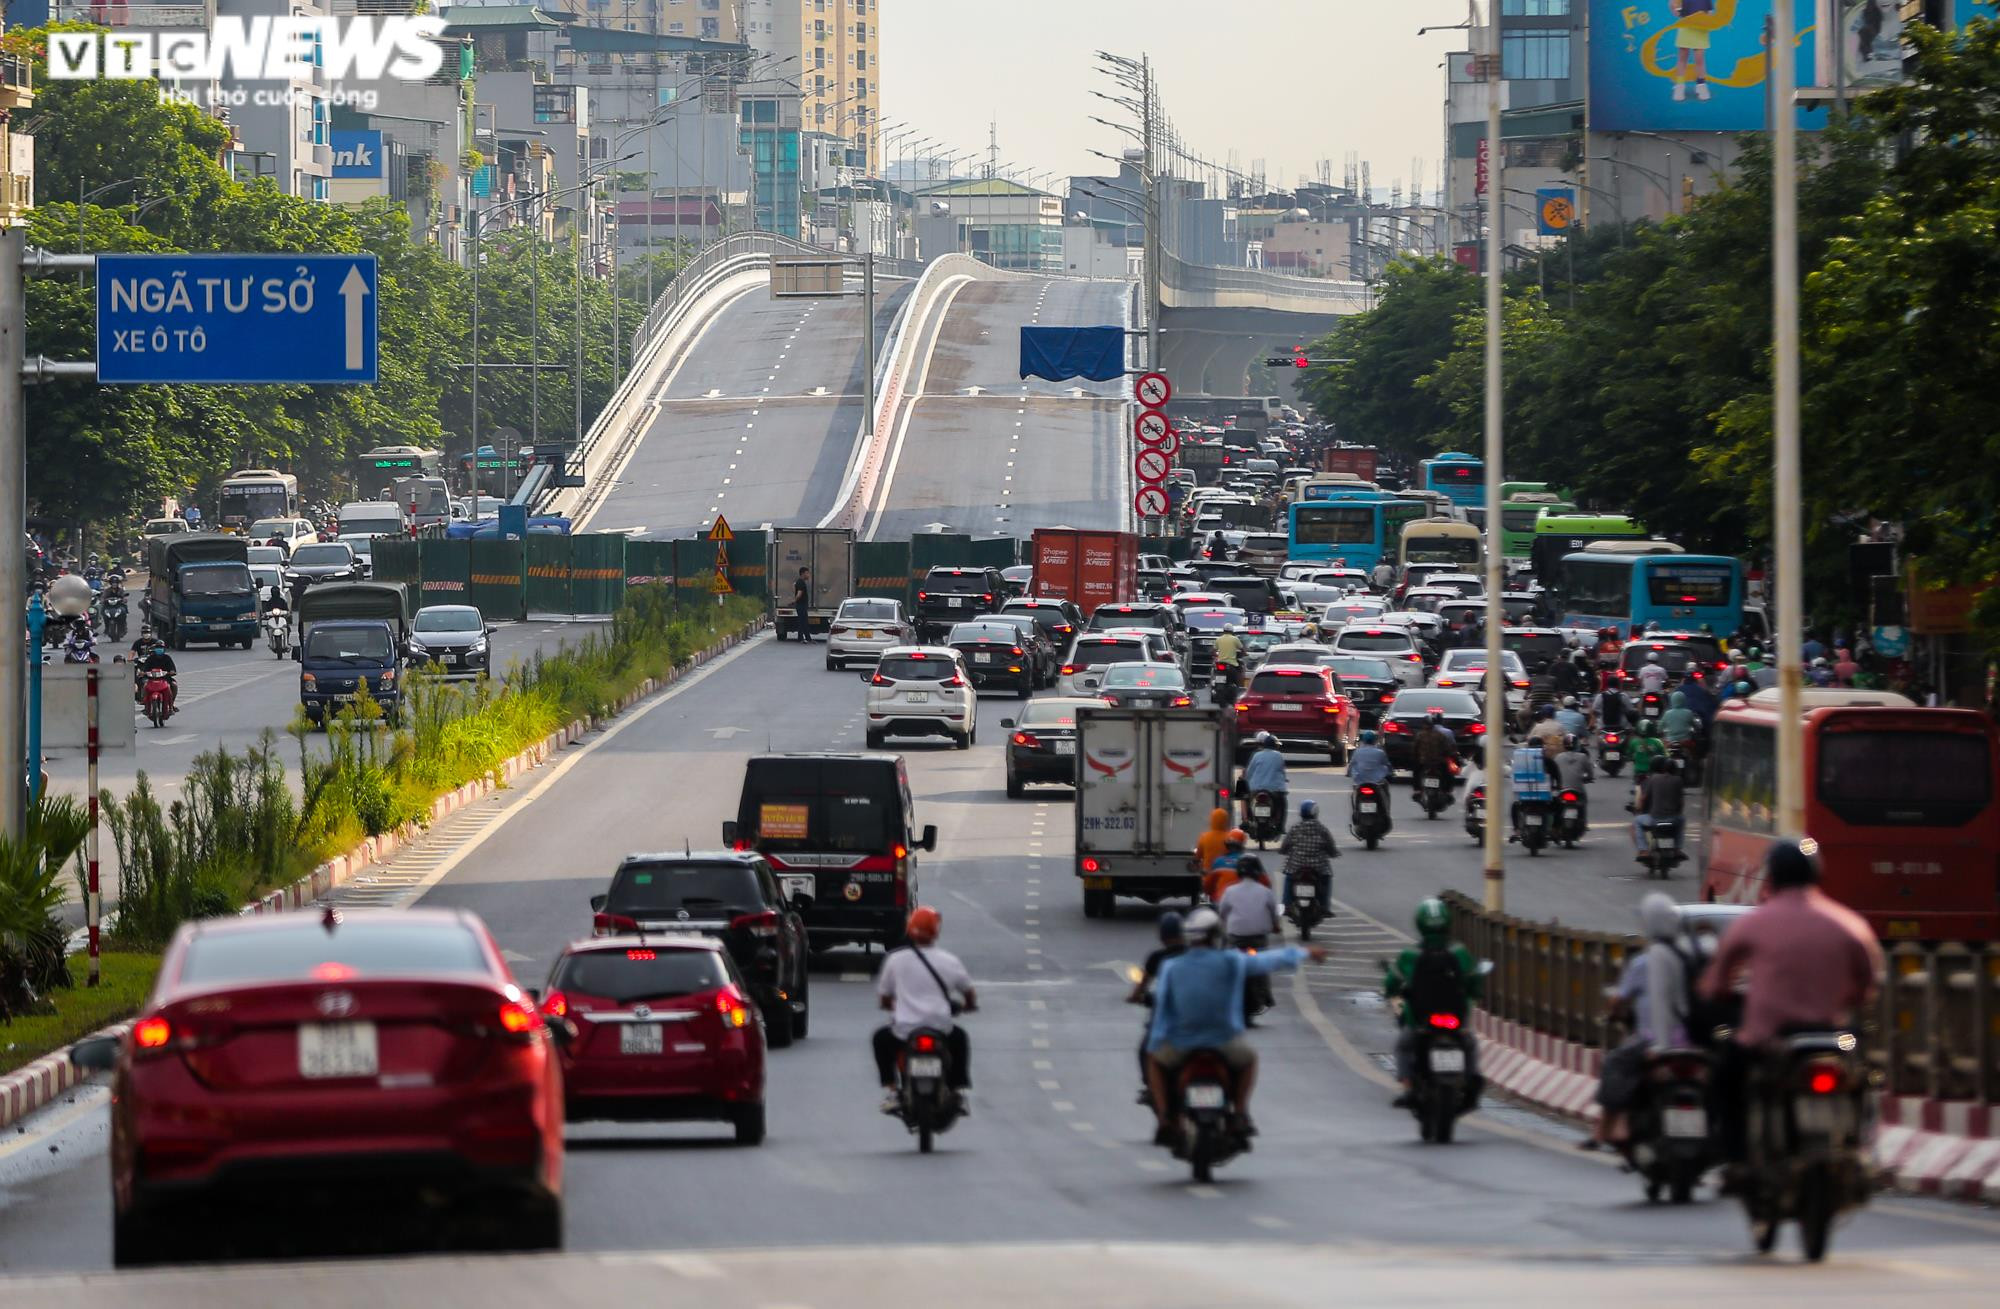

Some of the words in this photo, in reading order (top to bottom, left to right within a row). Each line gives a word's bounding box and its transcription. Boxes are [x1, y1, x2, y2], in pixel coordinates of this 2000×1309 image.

[111, 270, 193, 313] NGÃ
[197, 275, 254, 313] TƯ
[262, 266, 316, 314] SỞ
[113, 330, 145, 352] XE
[152, 325, 168, 352] Ô
[173, 325, 206, 352] TÔ
